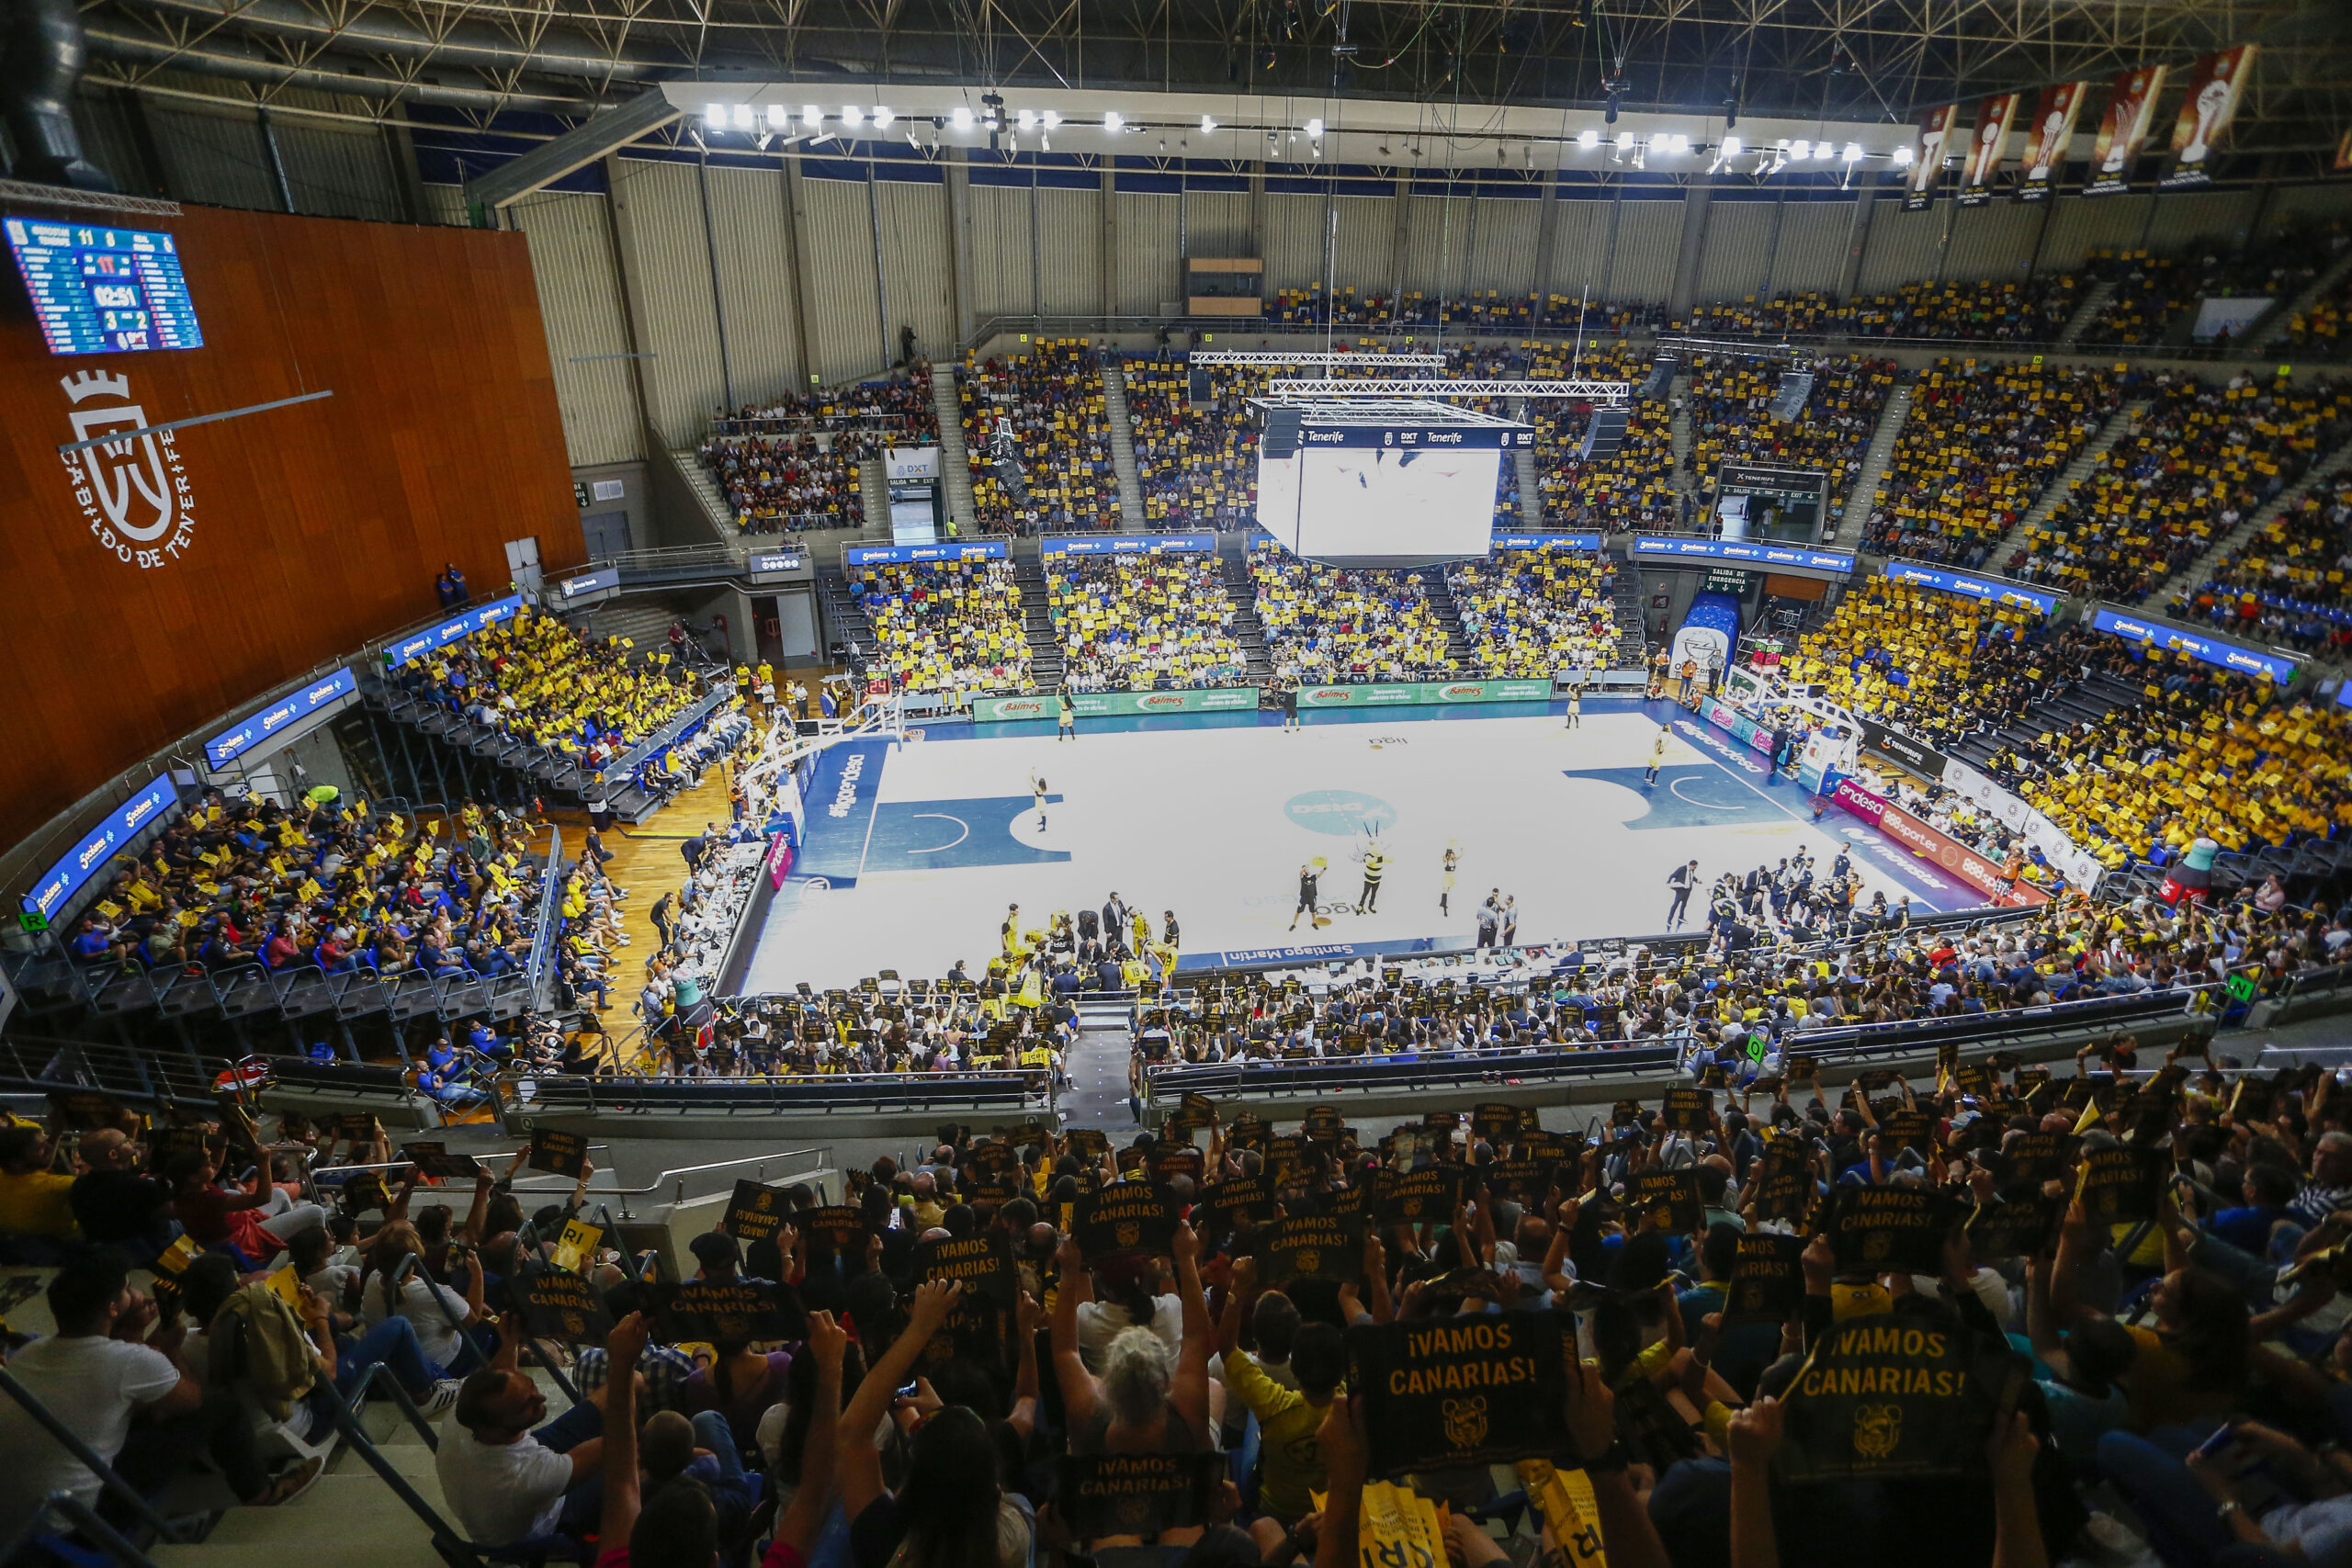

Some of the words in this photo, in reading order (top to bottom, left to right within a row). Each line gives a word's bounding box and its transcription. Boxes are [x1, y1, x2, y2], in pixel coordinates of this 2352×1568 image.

[78, 229, 94, 246] 11
[105, 311, 118, 330] 3
[136, 311, 148, 330] 2
[1307, 431, 1344, 444] Tenerife
[1400, 432, 1419, 440] DXT
[1427, 432, 1463, 445] Tenerife
[1517, 433, 1533, 441] DXT
[908, 464, 928, 473] DXT
[60, 450, 132, 563] CABILDO
[136, 548, 165, 569] DE
[159, 429, 196, 559] TENERIFE
[1708, 575, 1746, 585] EMERGENCIA
[1712, 568, 1734, 576] SALIDA
[1765, 653, 1781, 665] 24
[869, 681, 887, 693] 24
[1316, 689, 1351, 701] Balmes
[1449, 685, 1486, 697] Balmes
[1005, 700, 1043, 713] Balmes
[1148, 694, 1186, 706] Balmes
[1710, 704, 1735, 728] Kalise
[1751, 727, 1774, 751] Kalis
[1891, 740, 1924, 761] TENERIFE
[1839, 783, 1884, 816] endesa
[1884, 810, 1938, 852] 888sport.es
[770, 837, 788, 874] endesa
[26, 915, 41, 928] R
[1283, 944, 1354, 956] Santiago
[1759, 937, 1772, 947] 22
[1229, 950, 1283, 962] Martín
[2233, 981, 2246, 996] N
[1100, 1185, 1154, 1206] ¡VAMOS
[1222, 1179, 1257, 1194] ¡VAMOS
[1215, 1192, 1265, 1210] CANARIAS!
[1089, 1203, 1165, 1224] CANARIAS!
[1283, 1215, 1339, 1234] ¡VAMOS
[935, 1237, 989, 1260] ¡VAMOS
[1271, 1234, 1349, 1252] CANARIAS!
[926, 1257, 1001, 1281] CANARIAS!
[536, 1277, 589, 1295] ¡VAMOS
[529, 1293, 599, 1313] CANARIAS
[671, 1299, 777, 1314] CANARIAS!
[1408, 1323, 1513, 1359] ¡VAMOS
[1832, 1326, 1947, 1359] ¡VAMOS
[1388, 1357, 1537, 1396] CANARIAS!
[1802, 1371, 1967, 1398] CANARIAS!
[1098, 1458, 1177, 1475] ¡VAMOS
[1079, 1474, 1192, 1496] CANARIAS!
